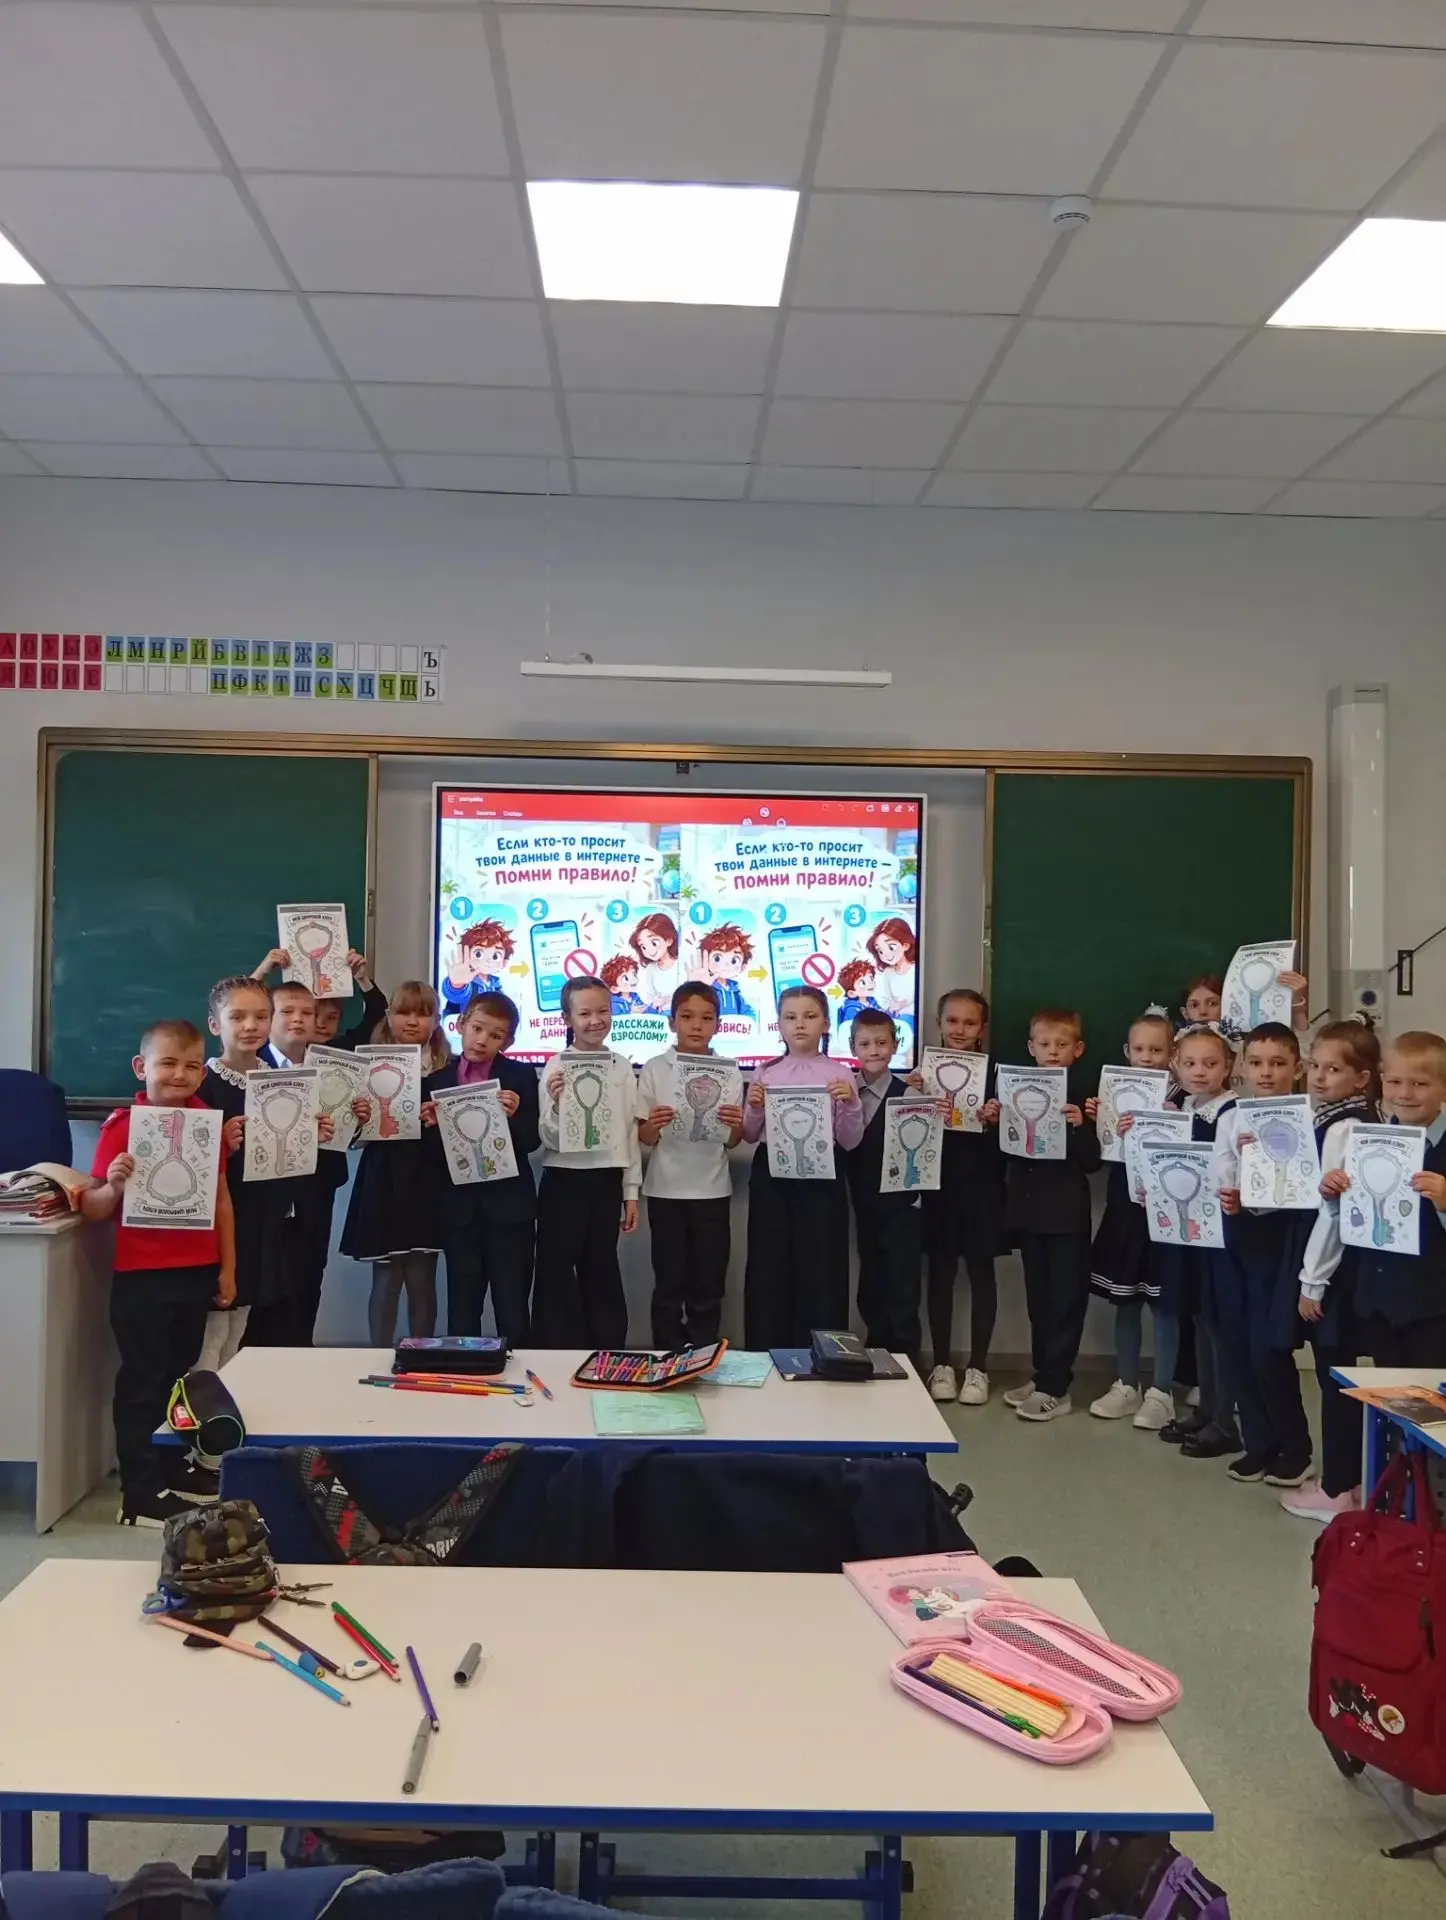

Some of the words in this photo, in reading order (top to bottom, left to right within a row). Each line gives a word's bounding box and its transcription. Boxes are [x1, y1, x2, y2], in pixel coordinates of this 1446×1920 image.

[108, 641, 122, 657] Л
[128, 641, 144, 658] М
[151, 642, 165, 658] Н
[172, 643, 184, 659] Р
[192, 640, 205, 660] Й
[212, 644, 225, 660] Б
[234, 644, 246, 661] В
[256, 645, 266, 661] Г
[275, 646, 288, 666] Д
[295, 646, 312, 663] Ж
[318, 647, 329, 664] З
[424, 652, 438, 668] Ъ
[212, 673, 226, 689] П
[232, 674, 248, 690] Ф
[253, 674, 267, 691] К
[276, 675, 288, 692] Т
[295, 676, 312, 692] Ш
[318, 676, 329, 693] С
[338, 677, 352, 694] Х
[360, 678, 374, 699] Ц
[381, 679, 394, 695] Ч
[400, 679, 418, 701] Щ
[425, 680, 436, 697] Ь
[497, 837, 528, 851] Если
[534, 837, 576, 848] кто-то
[580, 836, 626, 849] просит
[736, 842, 767, 856] Если
[772, 841, 814, 852] кто-то
[818, 841, 863, 854] просит
[476, 855, 506, 868] твои
[511, 853, 560, 866] данные
[564, 853, 573, 862] в
[577, 852, 641, 864] интернете
[714, 860, 745, 872] твои
[750, 857, 798, 871] данные
[802, 857, 811, 866] в
[814, 857, 878, 869] интернете
[495, 867, 552, 886] Помни
[558, 866, 638, 884] правило!
[733, 872, 790, 890] Помни
[796, 871, 875, 889] правило!
[530, 1019, 541, 1029] НЕ
[612, 1019, 665, 1031] РАССКАЖИ
[717, 1023, 752, 1035] ОВИСЬ!
[540, 1029, 566, 1040] ДАНН
[611, 1031, 667, 1043] ВЗРОСЛОМУ!
